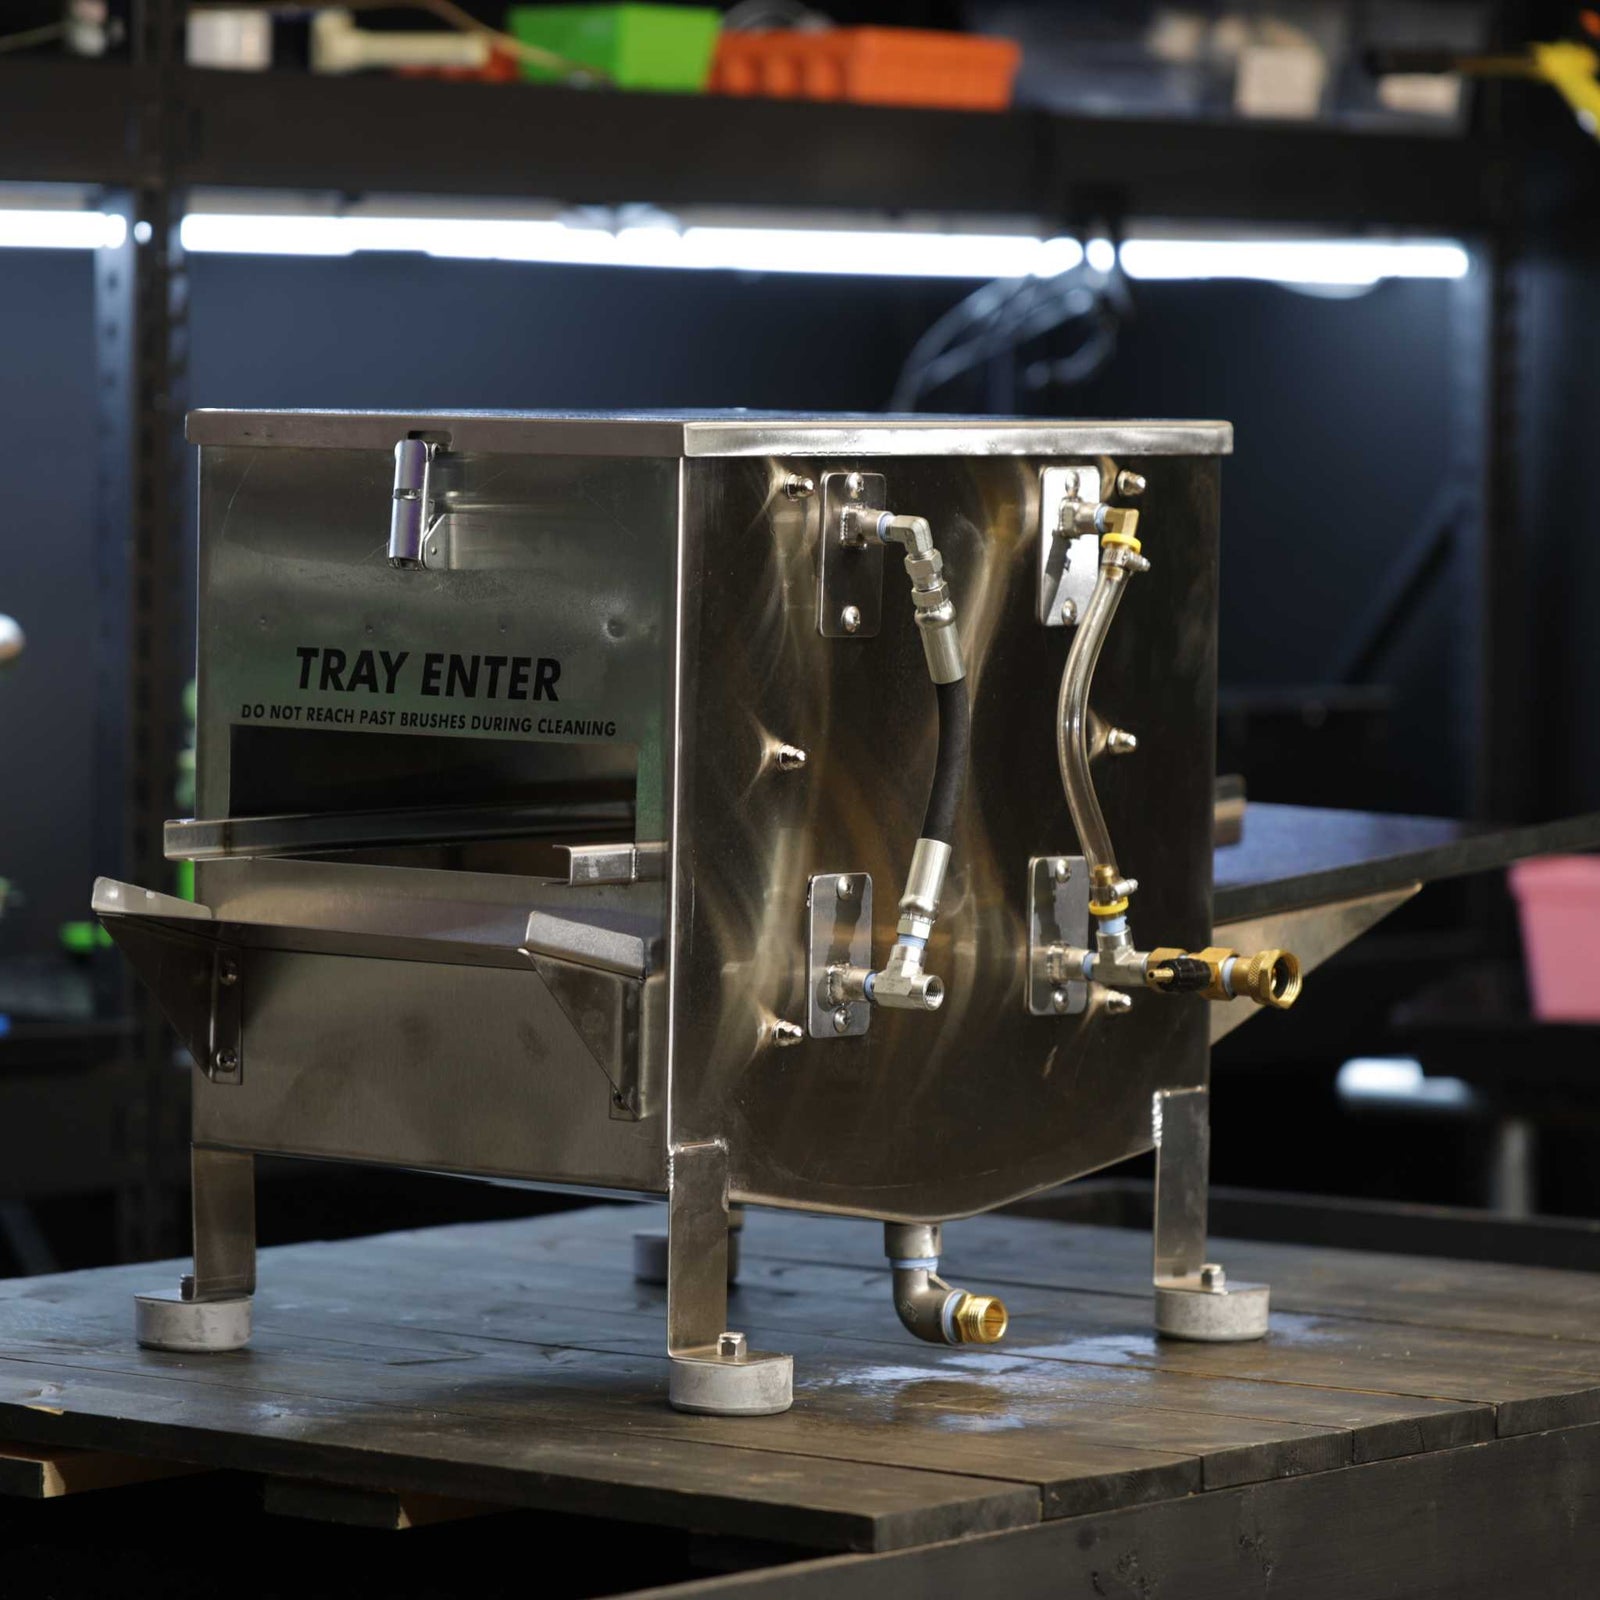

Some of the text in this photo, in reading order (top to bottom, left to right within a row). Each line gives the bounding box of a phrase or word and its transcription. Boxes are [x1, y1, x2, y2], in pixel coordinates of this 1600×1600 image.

[296, 647, 562, 702] TRAY ENTER
[241, 704, 617, 737] DO NOT REACH PAST BRUSHES DURING CLEANING
